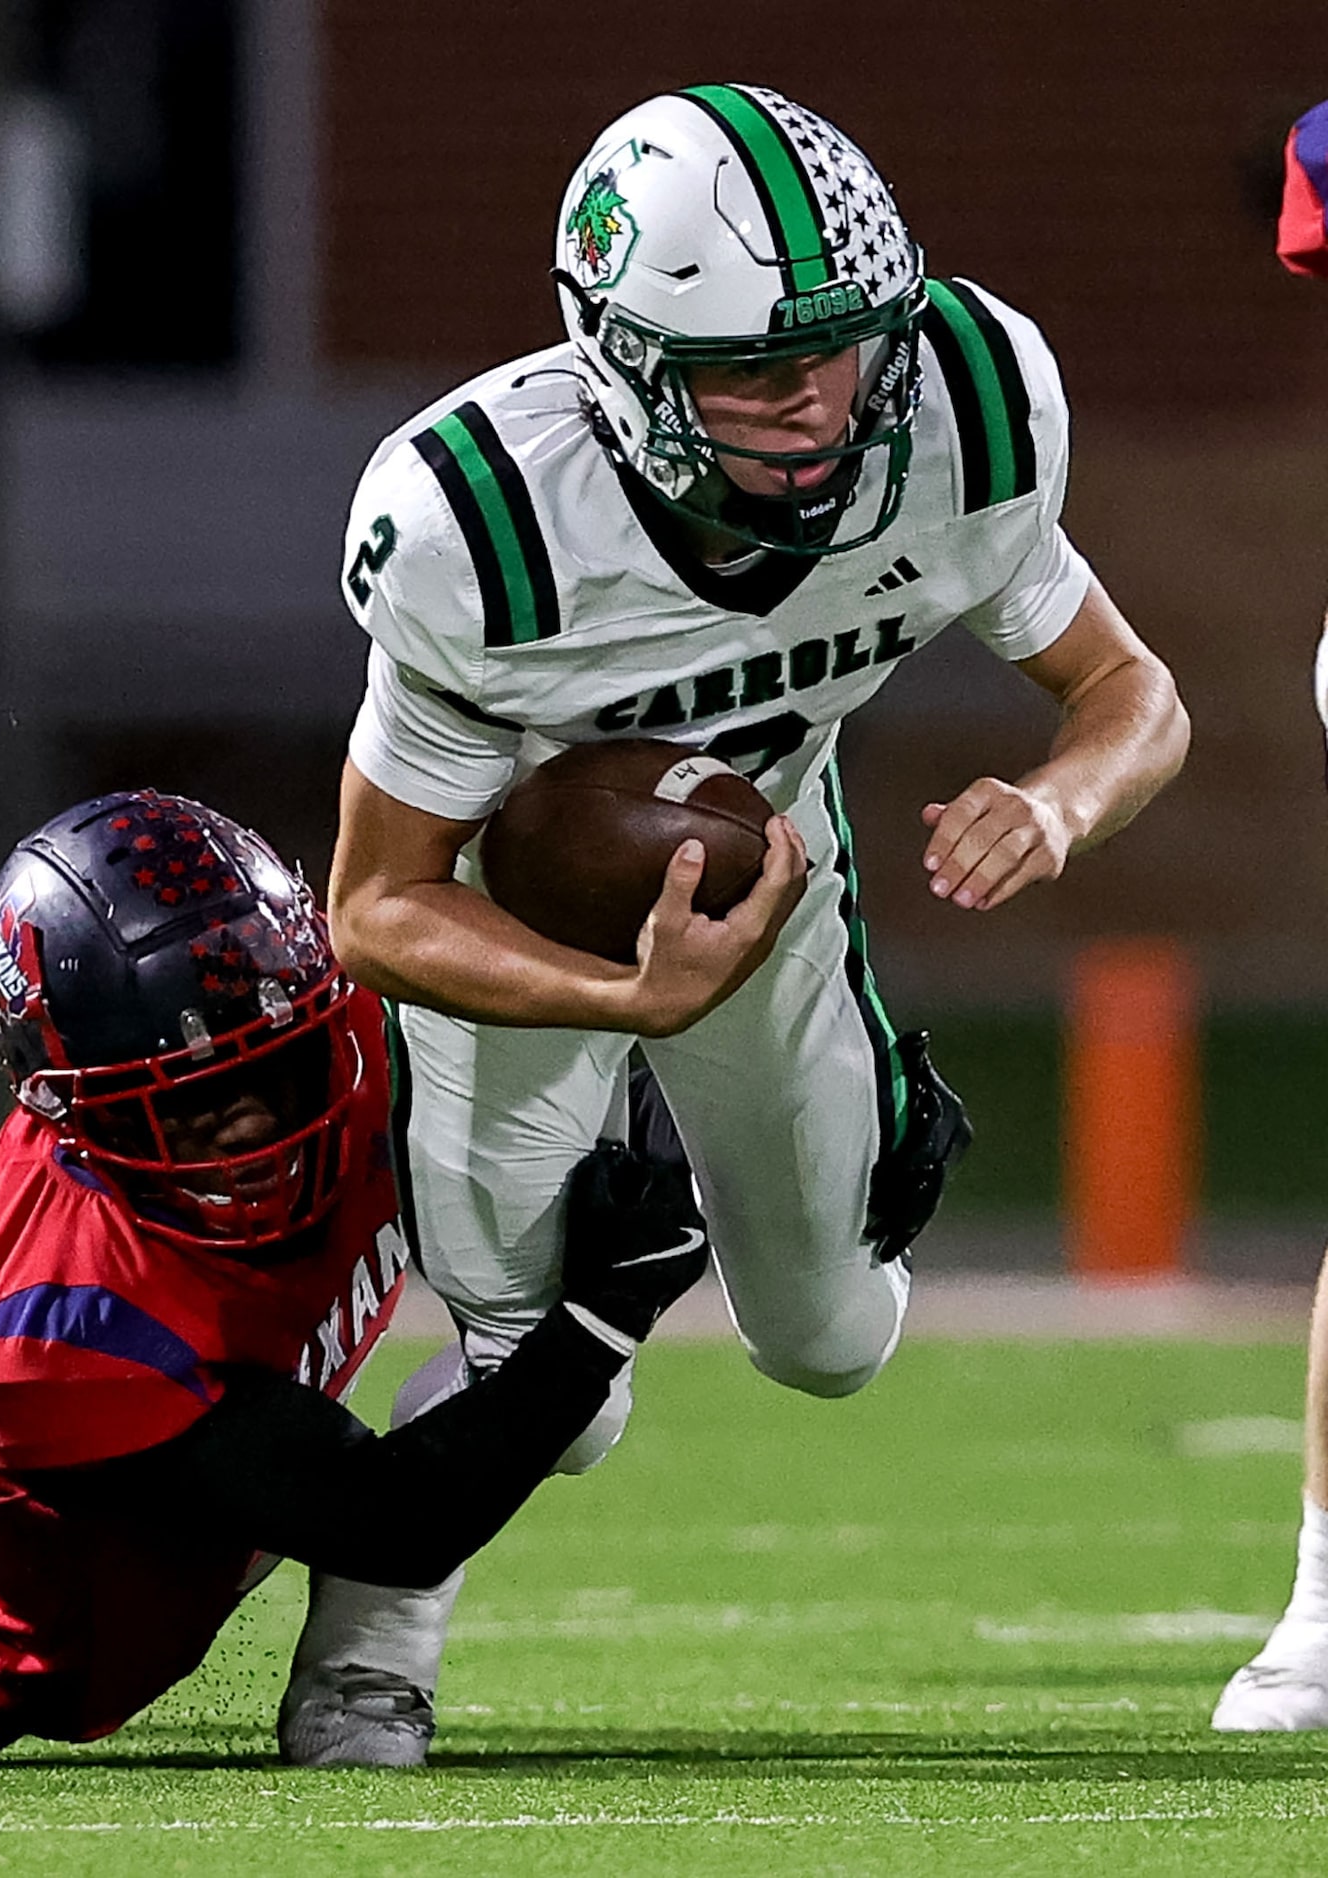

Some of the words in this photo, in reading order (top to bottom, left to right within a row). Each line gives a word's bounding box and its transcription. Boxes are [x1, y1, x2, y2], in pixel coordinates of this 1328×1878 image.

[776, 283, 865, 329] 76092
[346, 512, 399, 610] 2
[594, 613, 916, 731] CARROLL
